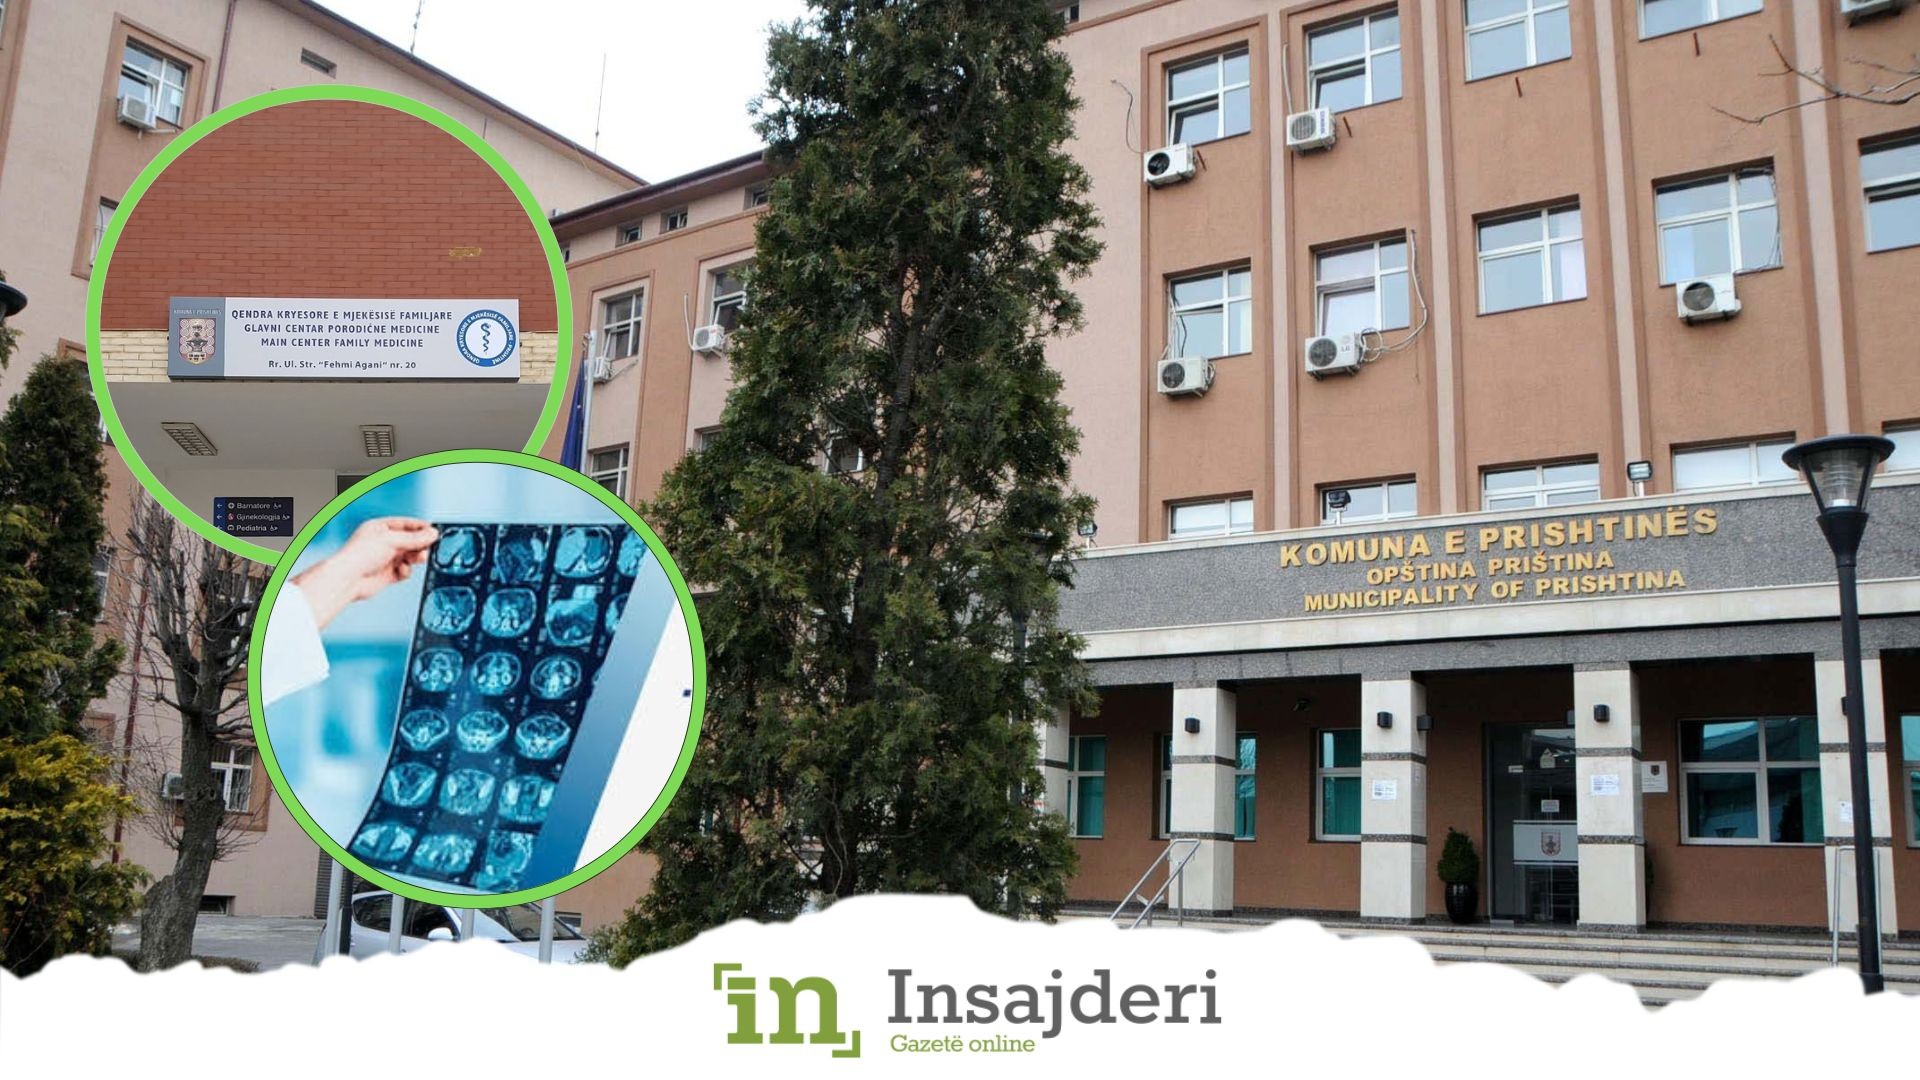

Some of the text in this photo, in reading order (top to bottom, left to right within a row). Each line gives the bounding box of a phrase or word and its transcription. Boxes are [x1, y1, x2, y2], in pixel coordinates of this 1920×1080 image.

[231, 309, 273, 319] QENDRA
[277, 310, 329, 319] KRYESORE
[333, 311, 339, 319] E
[343, 309, 396, 321] MJEKËSISË
[400, 311, 452, 321] FAMILJARE
[244, 323, 281, 332] GLAVNI
[285, 324, 324, 333] CENTAR
[390, 325, 440, 333] MEDICINE
[261, 338, 423, 347] MAIN CENTER FAMILY MEDICINE
[268, 360, 282, 368] Rr.
[284, 360, 297, 368] Ul.
[299, 360, 316, 368] Str.
[1280, 506, 1718, 568] KOMUNA E PRISHTINËS
[1366, 550, 1615, 586] OPŠTINA PRIŠTINA
[1304, 569, 1686, 612] MUNICIPALITY OF PRISHTINA
